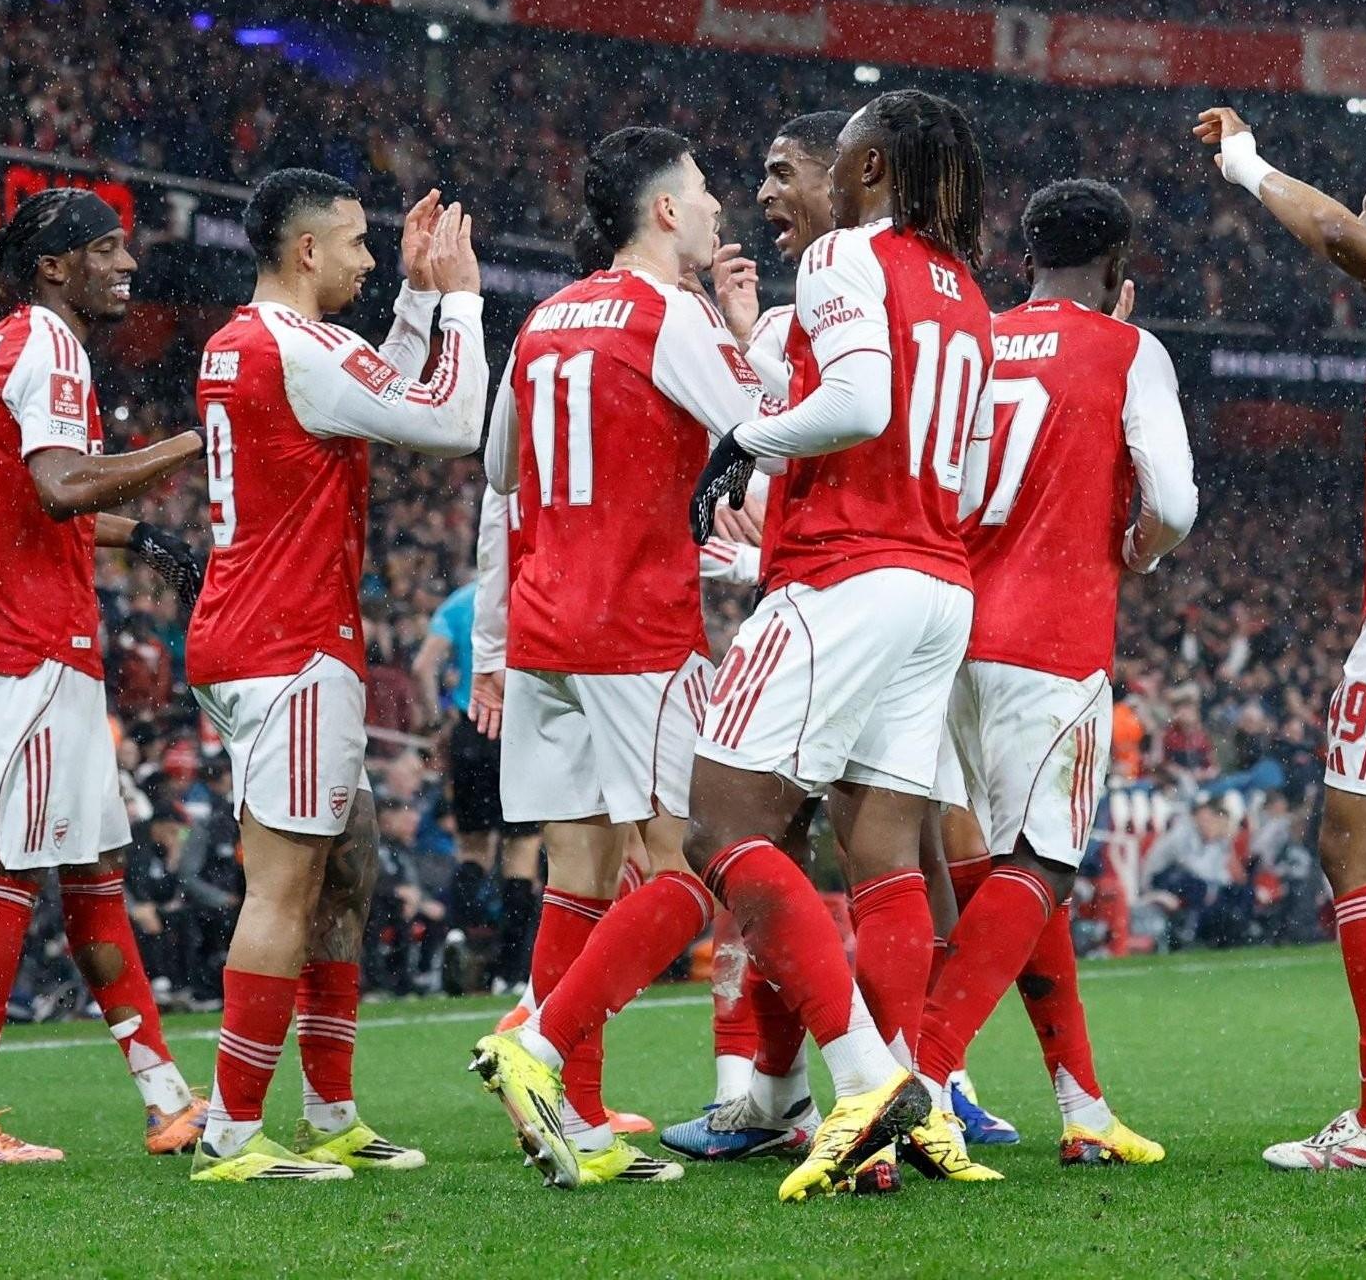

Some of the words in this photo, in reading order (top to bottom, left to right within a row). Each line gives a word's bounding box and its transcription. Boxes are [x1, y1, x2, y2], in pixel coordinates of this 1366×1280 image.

[928, 261, 962, 301] EZE
[527, 299, 635, 334] MARTINELLI
[810, 307, 864, 342] RWANDA
[812, 296, 844, 320] VISIT
[993, 332, 1059, 361] SAKA
[908, 320, 983, 494] 10
[527, 350, 595, 507] 11
[979, 376, 1051, 526] 7
[206, 402, 238, 548] 9
